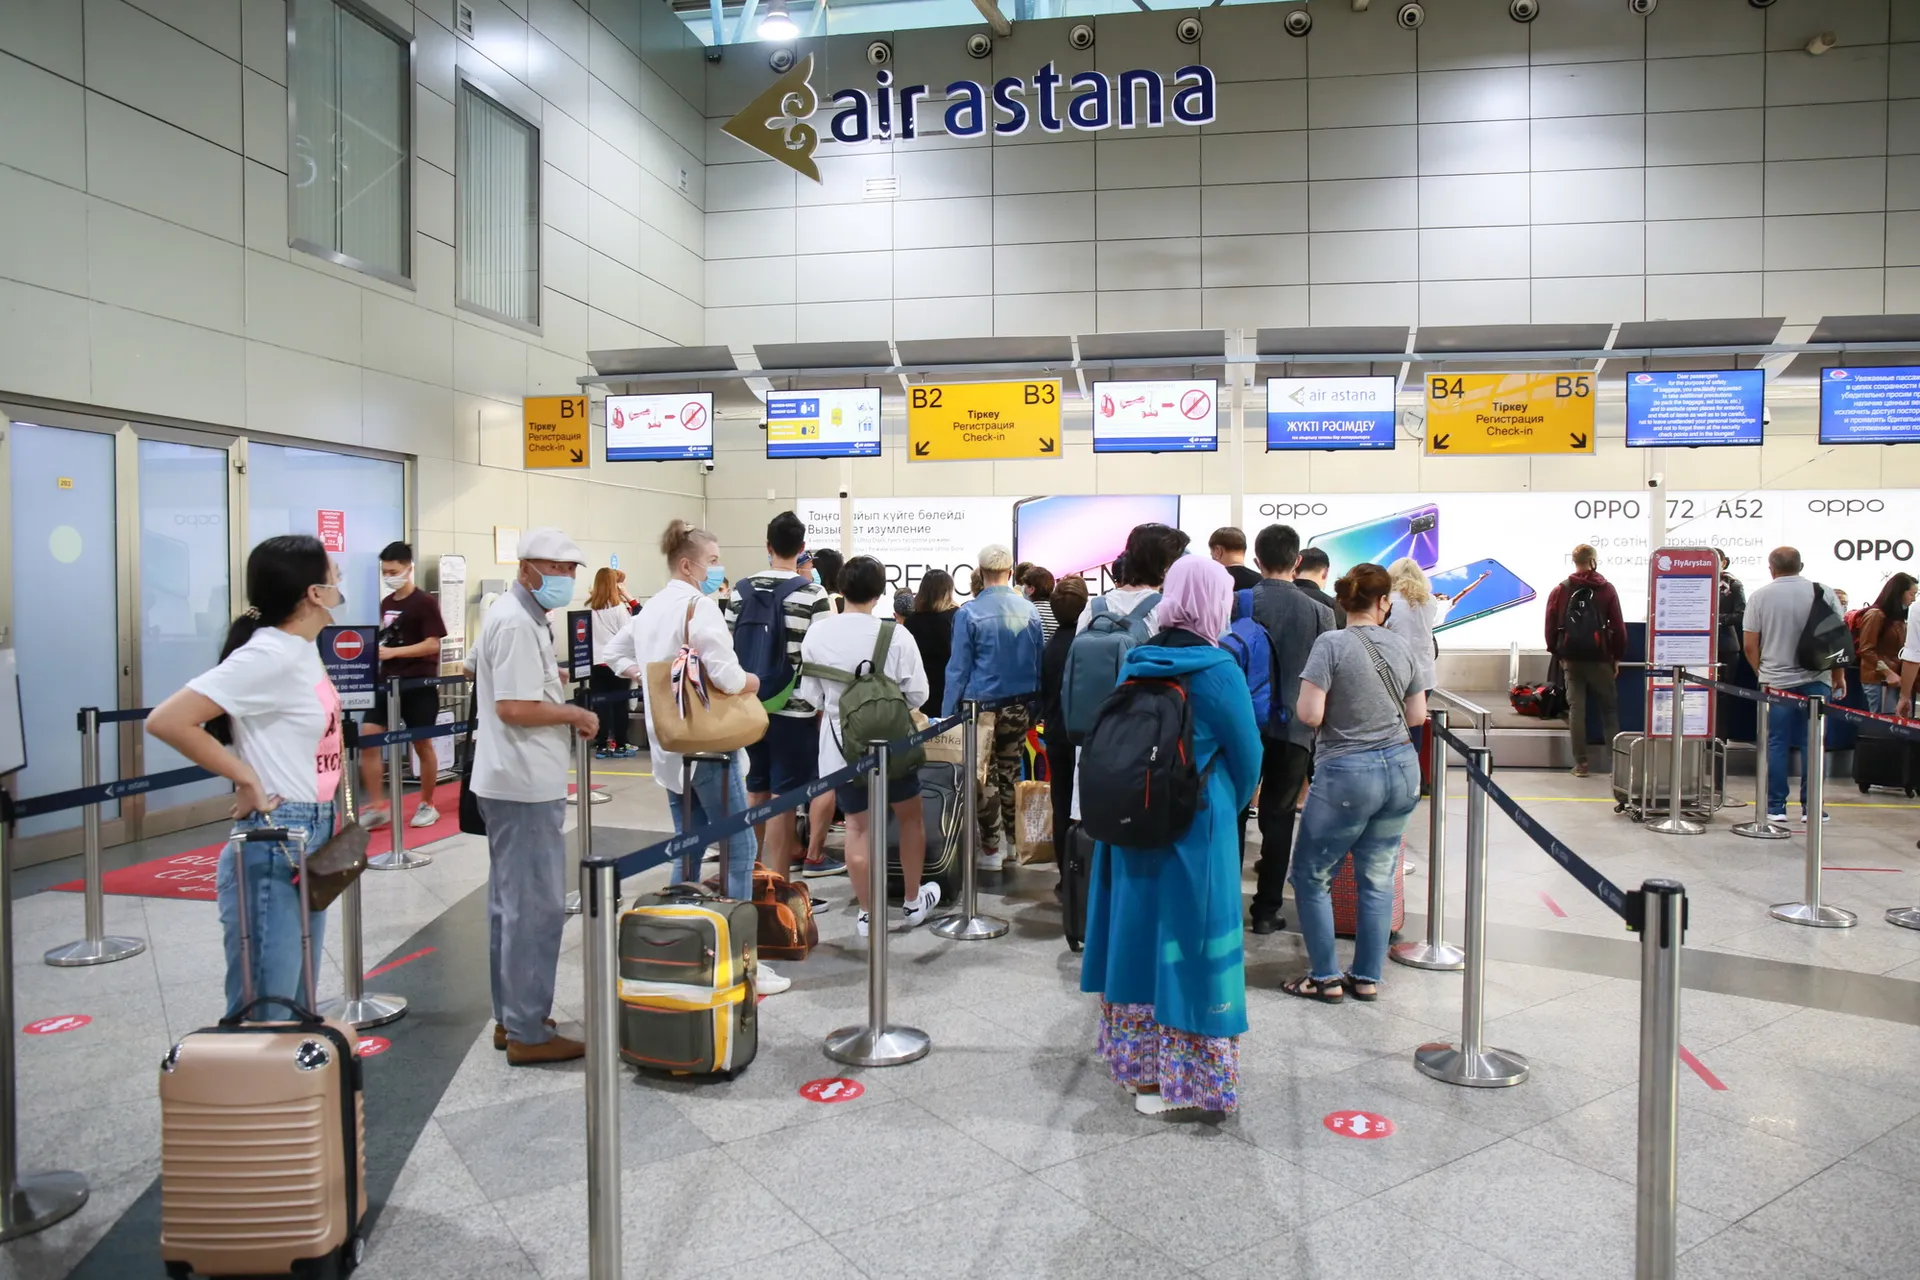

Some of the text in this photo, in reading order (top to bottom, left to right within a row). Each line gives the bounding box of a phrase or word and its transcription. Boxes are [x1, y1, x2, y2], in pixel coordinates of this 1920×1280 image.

[830, 59, 1216, 145] air astana
[1024, 383, 1056, 405] B3
[1432, 377, 1465, 399] B4
[1555, 376, 1590, 398] B5
[912, 388, 943, 409] B2
[1309, 388, 1376, 402] air astana
[560, 399, 585, 419] B1
[1491, 402, 1529, 413] Тіркеу
[967, 410, 1000, 421] Тіркеу
[1476, 414, 1544, 425] Регистрация
[528, 422, 557, 432] Тіркеу
[953, 421, 1015, 431] Регистрация
[1322, 420, 1376, 433] РӘСІМДЕУ
[1486, 426, 1534, 436] Check-in
[528, 433, 582, 442] Регистрация
[962, 432, 1006, 442] Check-in
[528, 443, 566, 452] Check-in
[1258, 502, 1329, 520] oppo
[1574, 499, 1764, 519] OPPO 72 A52
[1807, 498, 1886, 517] oppo
[882, 510, 915, 523] күйге
[917, 508, 965, 521] бөлейді
[867, 525, 931, 536] изумление
[1711, 533, 1763, 547] болсын
[1833, 538, 1915, 562] OPPO
[1673, 558, 1712, 569] FlyArystan
